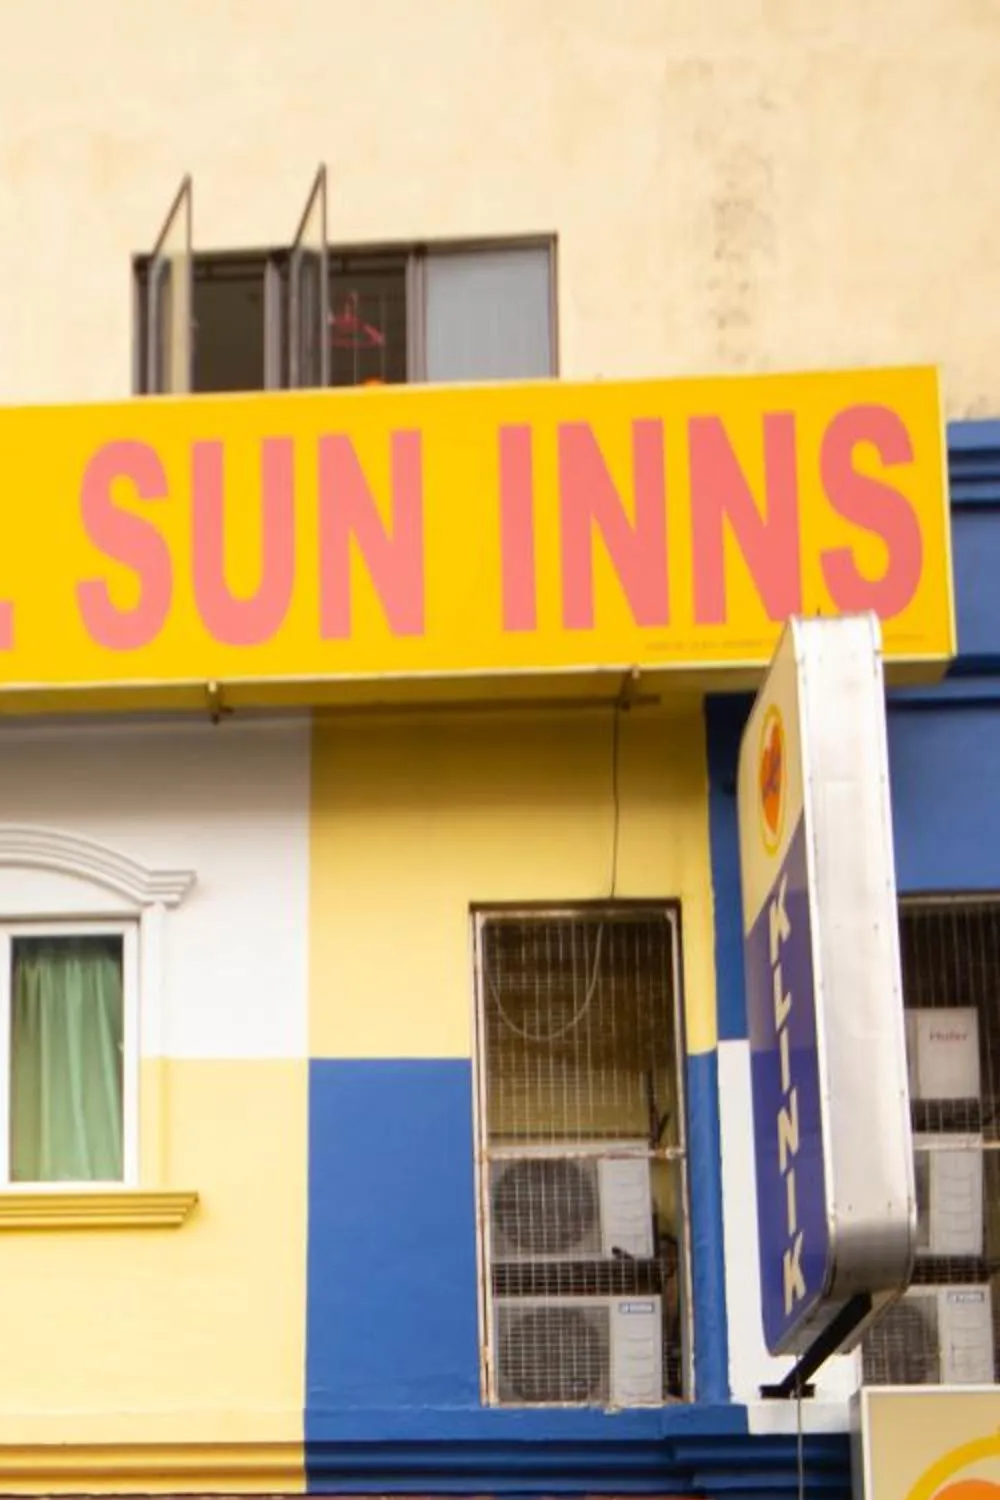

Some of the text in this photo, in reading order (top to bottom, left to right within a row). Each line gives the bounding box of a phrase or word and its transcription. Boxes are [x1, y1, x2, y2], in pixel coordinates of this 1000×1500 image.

[76, 438, 425, 652] SUN
[500, 402, 923, 632] INNS
[769, 872, 807, 1316] KLINIK
